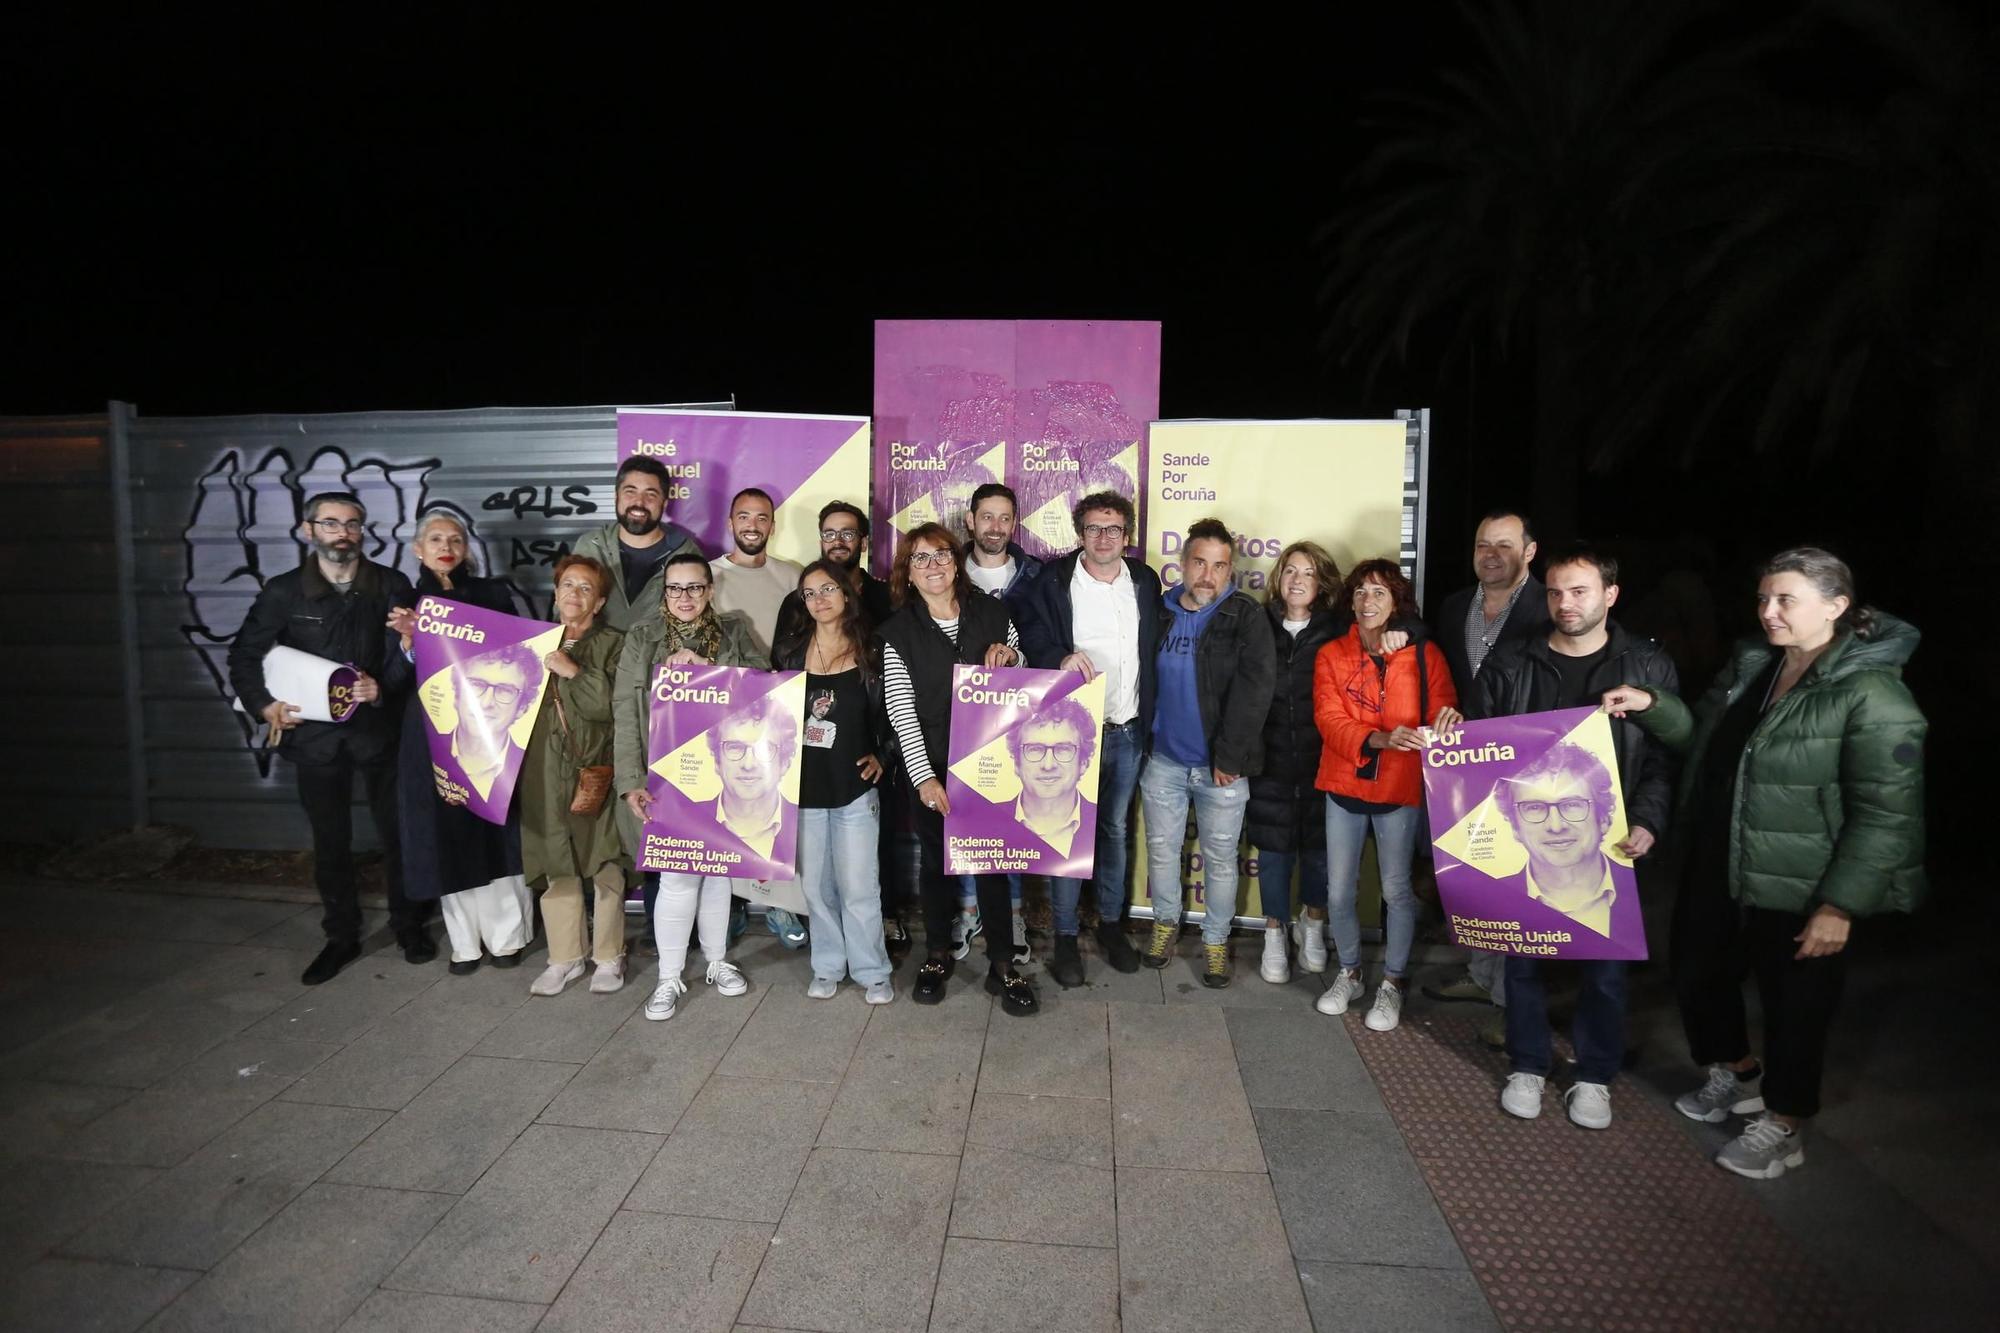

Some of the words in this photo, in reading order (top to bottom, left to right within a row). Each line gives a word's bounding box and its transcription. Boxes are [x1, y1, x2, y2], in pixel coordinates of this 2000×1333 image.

[631, 440, 677, 456] José
[891, 443, 918, 457] Por
[1023, 443, 1051, 457] Por
[891, 457, 947, 471] Coruña
[1023, 457, 1080, 472] Coruña
[1162, 453, 1210, 466] Sande
[1162, 470, 1188, 483] Por
[1161, 487, 1216, 501] Coruña
[419, 598, 454, 619] Por
[417, 615, 486, 644] Coruña
[658, 666, 692, 684] Por
[959, 667, 993, 686] Por
[656, 684, 730, 704] Coruña
[957, 685, 1030, 707] Coruña
[1423, 728, 1465, 749] Por
[1427, 742, 1516, 768] Coruña
[646, 835, 705, 849] Podemos
[950, 837, 1004, 848] Podemos
[644, 846, 704, 862] Esquerda
[706, 849, 742, 864] Unida
[950, 847, 1005, 860] Esquerda
[1007, 849, 1041, 860] Unida
[642, 857, 689, 871] Alianza
[691, 861, 728, 874] Verde
[950, 859, 992, 871] Alianza
[993, 859, 1029, 870] Verde
[1451, 915, 1521, 931] Podemos
[1455, 926, 1523, 944] Esquerda
[1525, 931, 1572, 943] Unida
[1458, 937, 1509, 952] Alianza
[1511, 943, 1558, 956] Verde
